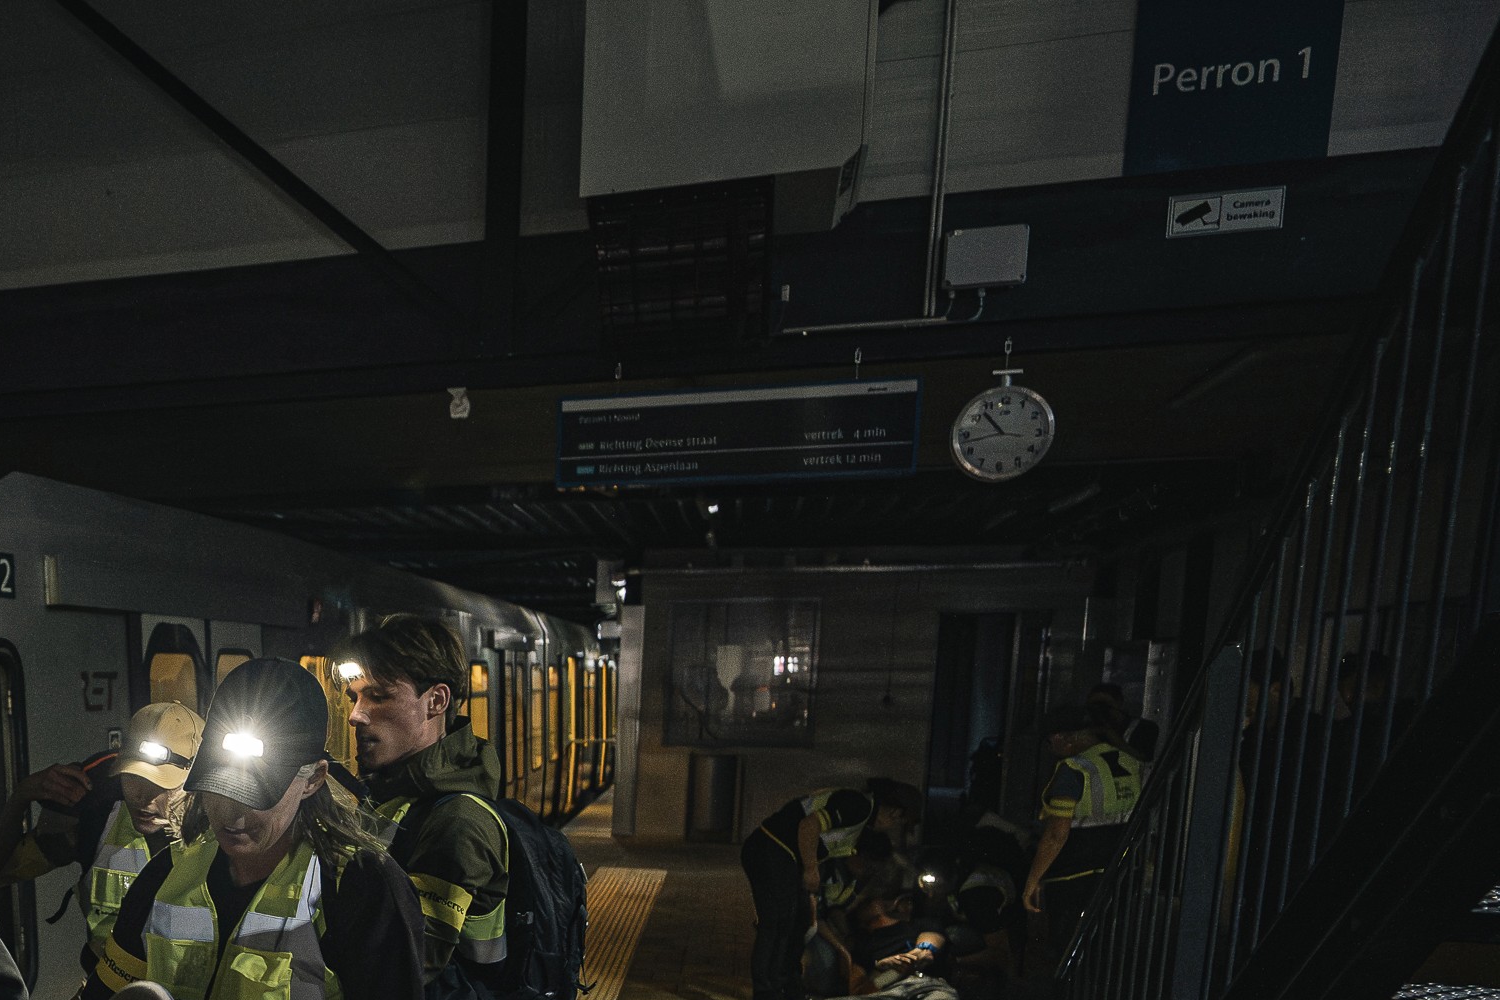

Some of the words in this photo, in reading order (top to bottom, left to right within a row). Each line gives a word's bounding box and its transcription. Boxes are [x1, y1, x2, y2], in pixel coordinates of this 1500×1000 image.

[1152, 57, 1281, 96] Perron
[1297, 46, 1312, 79] 1
[1226, 209, 1275, 221] bewaking
[1232, 198, 1271, 209] Camera
[599, 439, 643, 452] Richting
[803, 427, 844, 441] vertrek
[863, 426, 887, 438] min
[599, 463, 643, 475] Richting
[802, 453, 843, 466] vertrek
[859, 452, 882, 464] min
